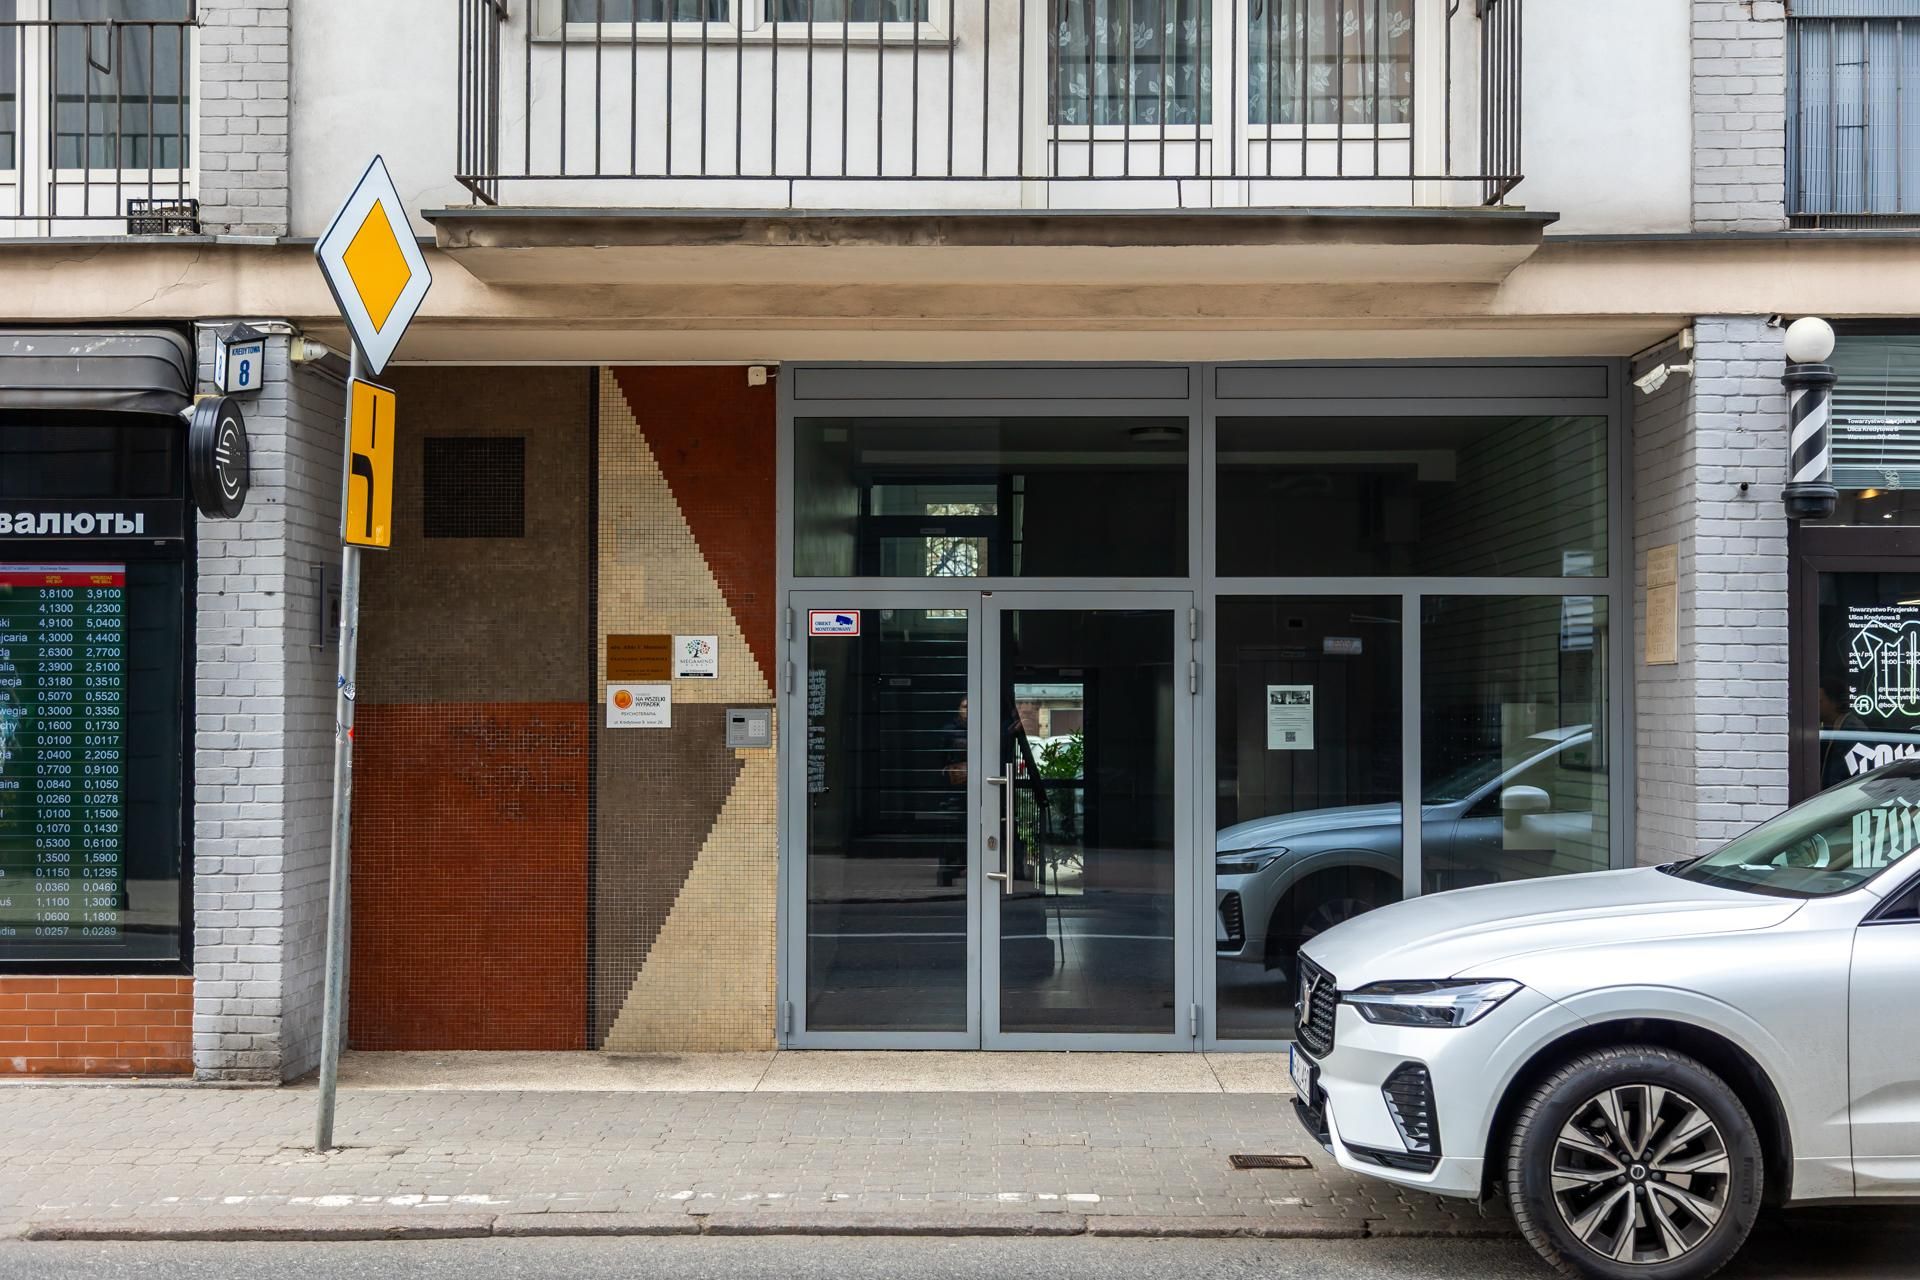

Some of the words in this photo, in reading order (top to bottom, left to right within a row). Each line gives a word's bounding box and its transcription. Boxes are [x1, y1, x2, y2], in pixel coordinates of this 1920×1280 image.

[232, 345, 260, 356] KREDYTOWA
[239, 360, 250, 386] 8
[40, 589, 73, 599] 3,8100
[87, 589, 120, 599] 3,9100
[39, 604, 73, 614] 4,1300
[87, 604, 120, 614] 4,2300
[39, 618, 73, 629] 4,9100
[87, 618, 120, 629] 5,0400
[39, 633, 73, 643] 4,3000
[86, 633, 120, 643] 4,4400
[39, 648, 72, 658] 2,6300
[86, 648, 120, 658] 2,7700
[39, 662, 72, 673] 2,3900
[86, 662, 120, 673] 2,5100
[38, 677, 72, 687] 0,3180
[86, 677, 119, 687] 0,3510
[38, 692, 72, 702] 0,5070
[86, 692, 119, 702] 0,5520
[38, 706, 72, 717] 0,3000
[86, 706, 119, 717] 0,3350
[38, 721, 71, 731] 0,1600
[85, 721, 119, 731] 0,1730
[38, 736, 71, 746] 0,0100
[85, 736, 118, 746] 0,0117
[37, 750, 71, 760] 2,0400
[85, 750, 118, 760] 2,2050
[37, 765, 71, 775] 0,7700
[85, 765, 118, 775] 0,9100
[37, 780, 70, 790] 0,0840
[85, 780, 118, 790] 0,1050
[37, 794, 70, 804] 0,0260
[84, 794, 118, 804] 0,0278
[38, 809, 70, 819] 1,0100
[86, 809, 118, 819] 1,1500
[37, 824, 70, 834] 0,1070
[84, 824, 117, 834] 0,1430
[36, 838, 70, 848] 0,5300
[84, 838, 117, 848] 0,6100
[37, 853, 69, 863] 1,3500
[85, 853, 117, 863] 1,5900
[36, 867, 69, 878] 0,1150
[84, 867, 117, 878] 0,1295
